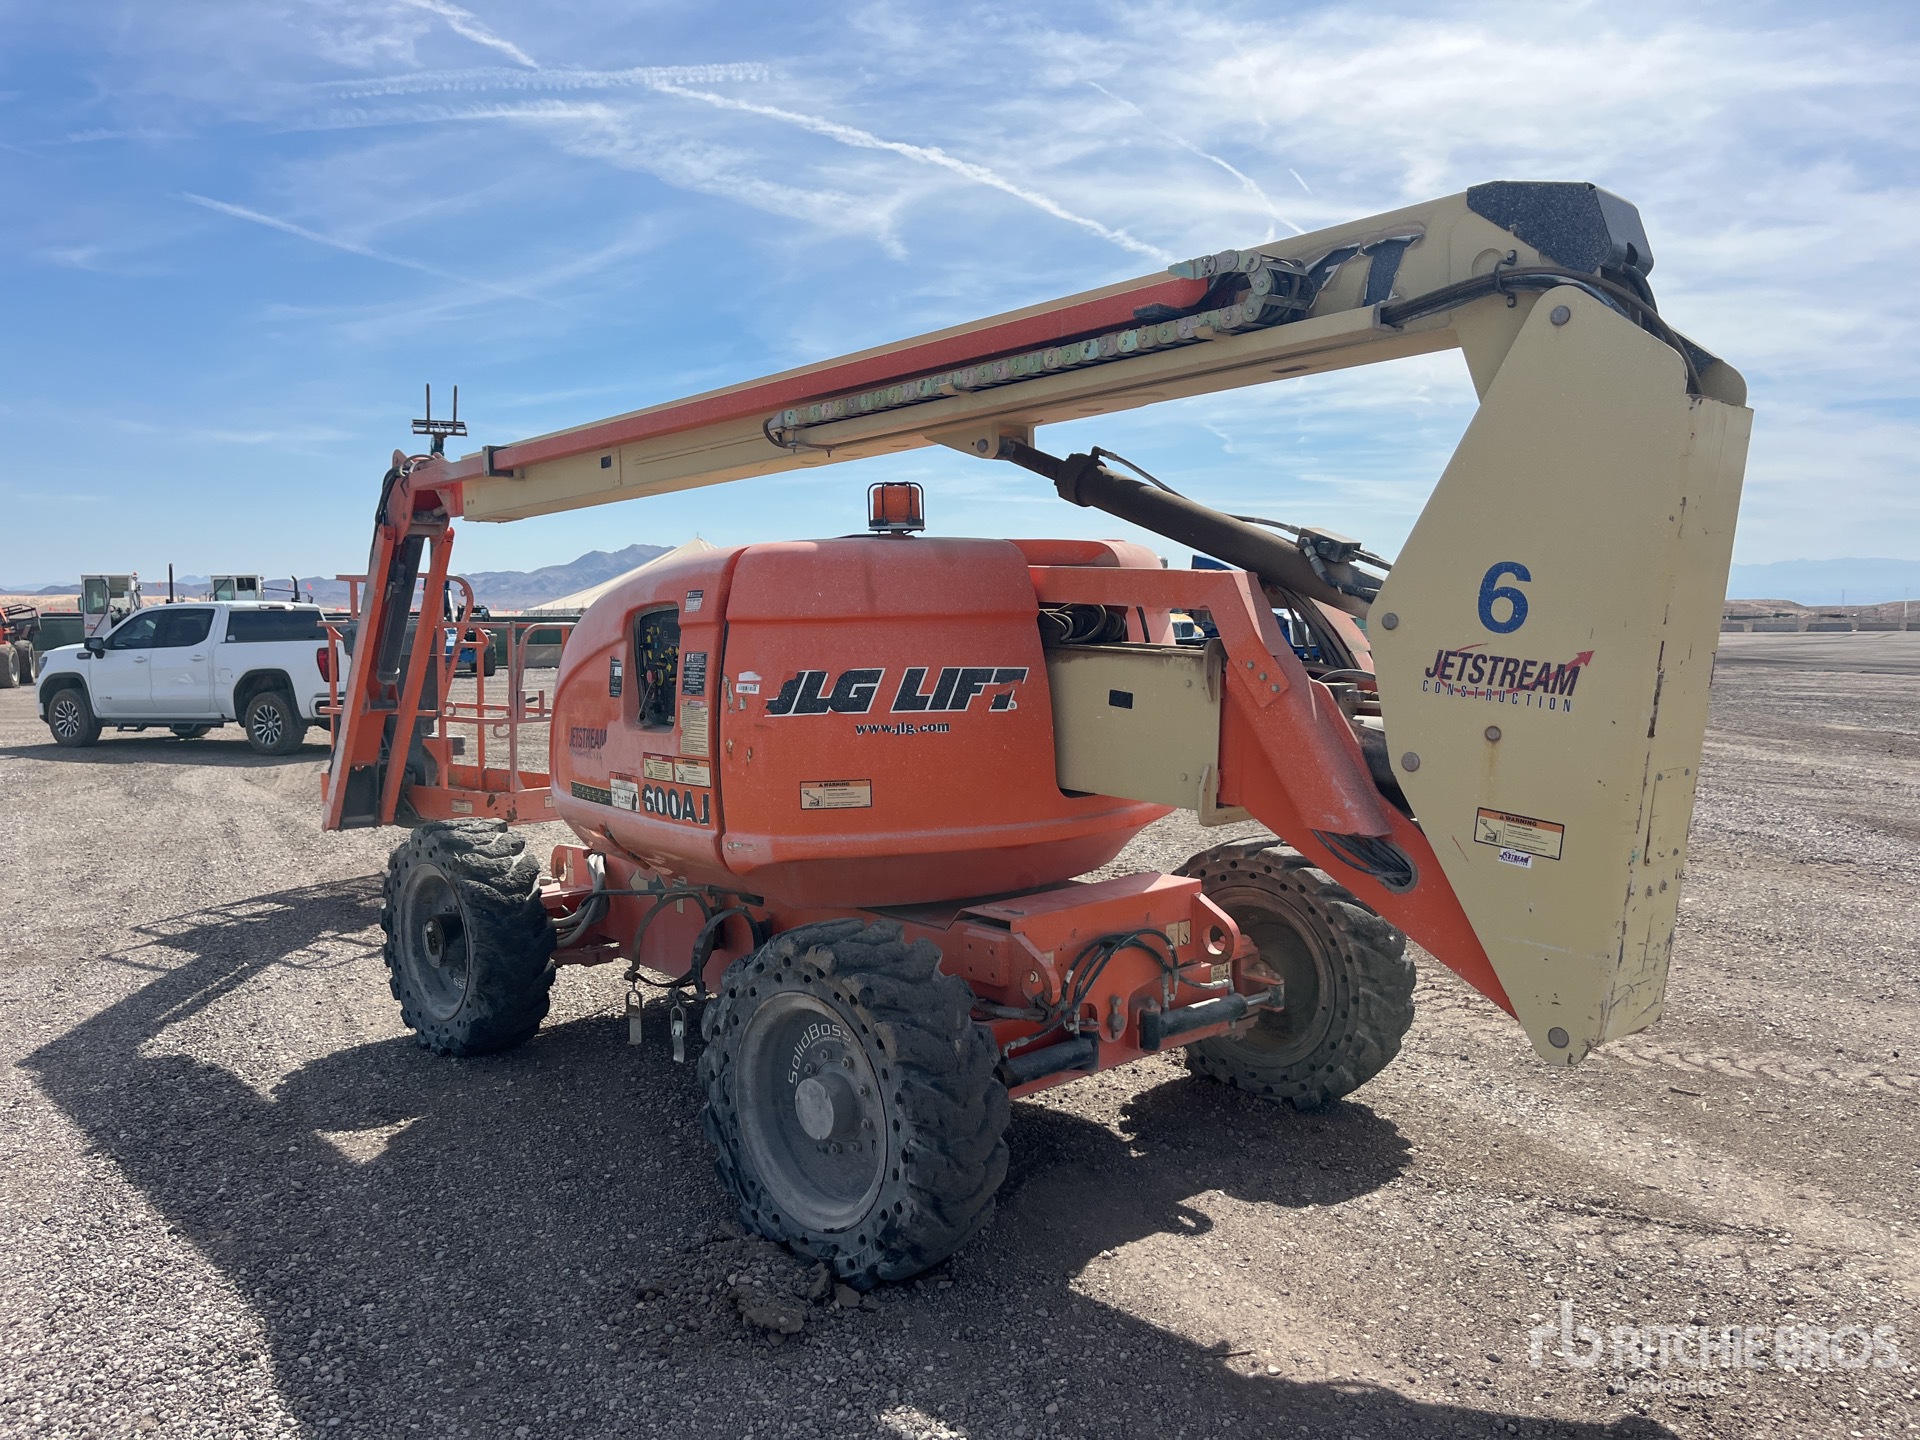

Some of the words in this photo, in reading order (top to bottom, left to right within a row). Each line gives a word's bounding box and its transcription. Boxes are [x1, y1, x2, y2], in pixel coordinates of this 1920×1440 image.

[1477, 561, 1532, 634] 6
[764, 668, 886, 717] JLG
[890, 667, 1029, 714] LIFT
[1425, 649, 1581, 697] JETSTREAM
[1422, 679, 1572, 712] CONSTRUCTION
[569, 727, 607, 749] JETSTREAM
[855, 722, 950, 736] www.jlg.com
[642, 783, 710, 826] 600AJ
[1505, 815, 1537, 827] WARNING
